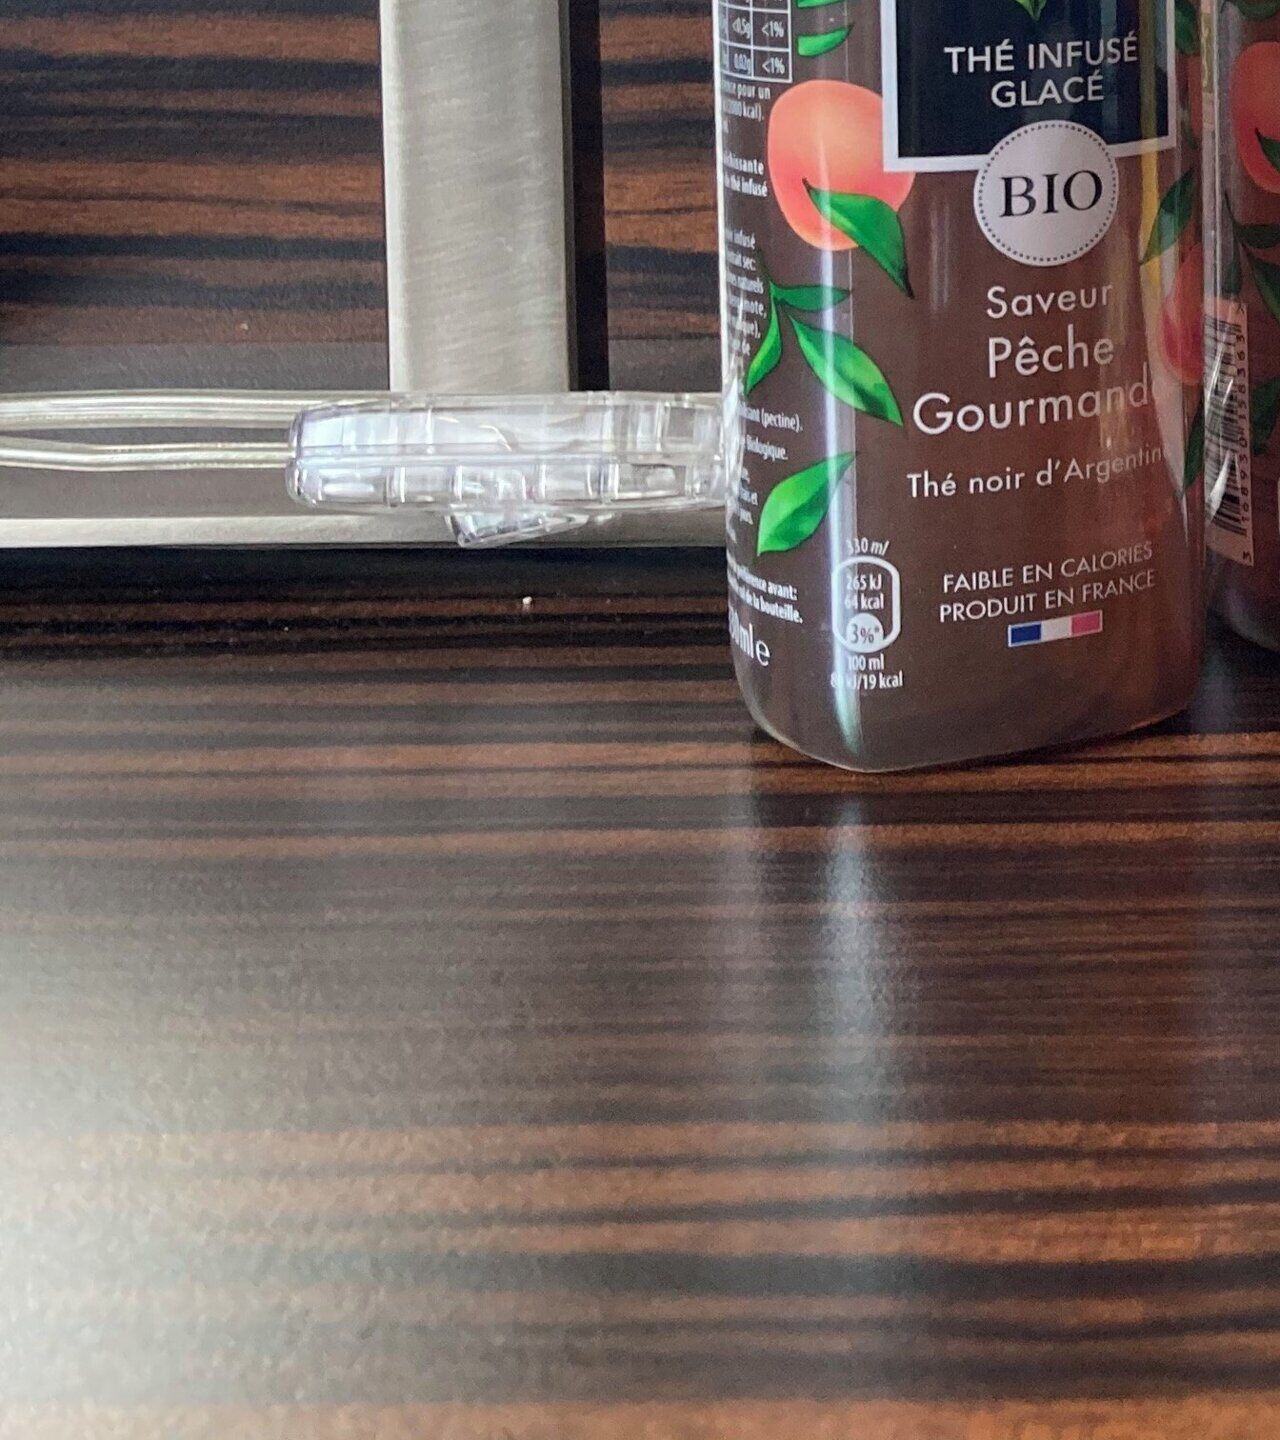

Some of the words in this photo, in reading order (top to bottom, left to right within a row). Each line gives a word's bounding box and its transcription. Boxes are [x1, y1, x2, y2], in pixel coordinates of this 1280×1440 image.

[761, 20, 785, 38] <1%
[762, 56, 786, 74] <1%
[943, 38, 1016, 75] THÉ
[1027, 30, 1140, 72] INFUSÉ
[757, 87, 771, 100] un
[990, 72, 1105, 109] GLACÉ
[999, 169, 1104, 218] BIO
[986, 282, 1113, 320] Saveur
[987, 323, 1115, 379] Pêche
[912, 361, 1149, 436] Gourmand
[906, 469, 957, 499] Thé
[968, 466, 1026, 495] noir
[943, 567, 1014, 594] FAIBLE
[1022, 562, 1053, 585] EN
[1060, 541, 1154, 578] CALORIES
[860, 594, 885, 611] kcal
[939, 592, 1038, 623] PRODUIT
[1044, 586, 1075, 610] EN
[1082, 569, 1156, 604] FRANCE
[868, 652, 885, 671] ml
[879, 670, 903, 689] kcal
